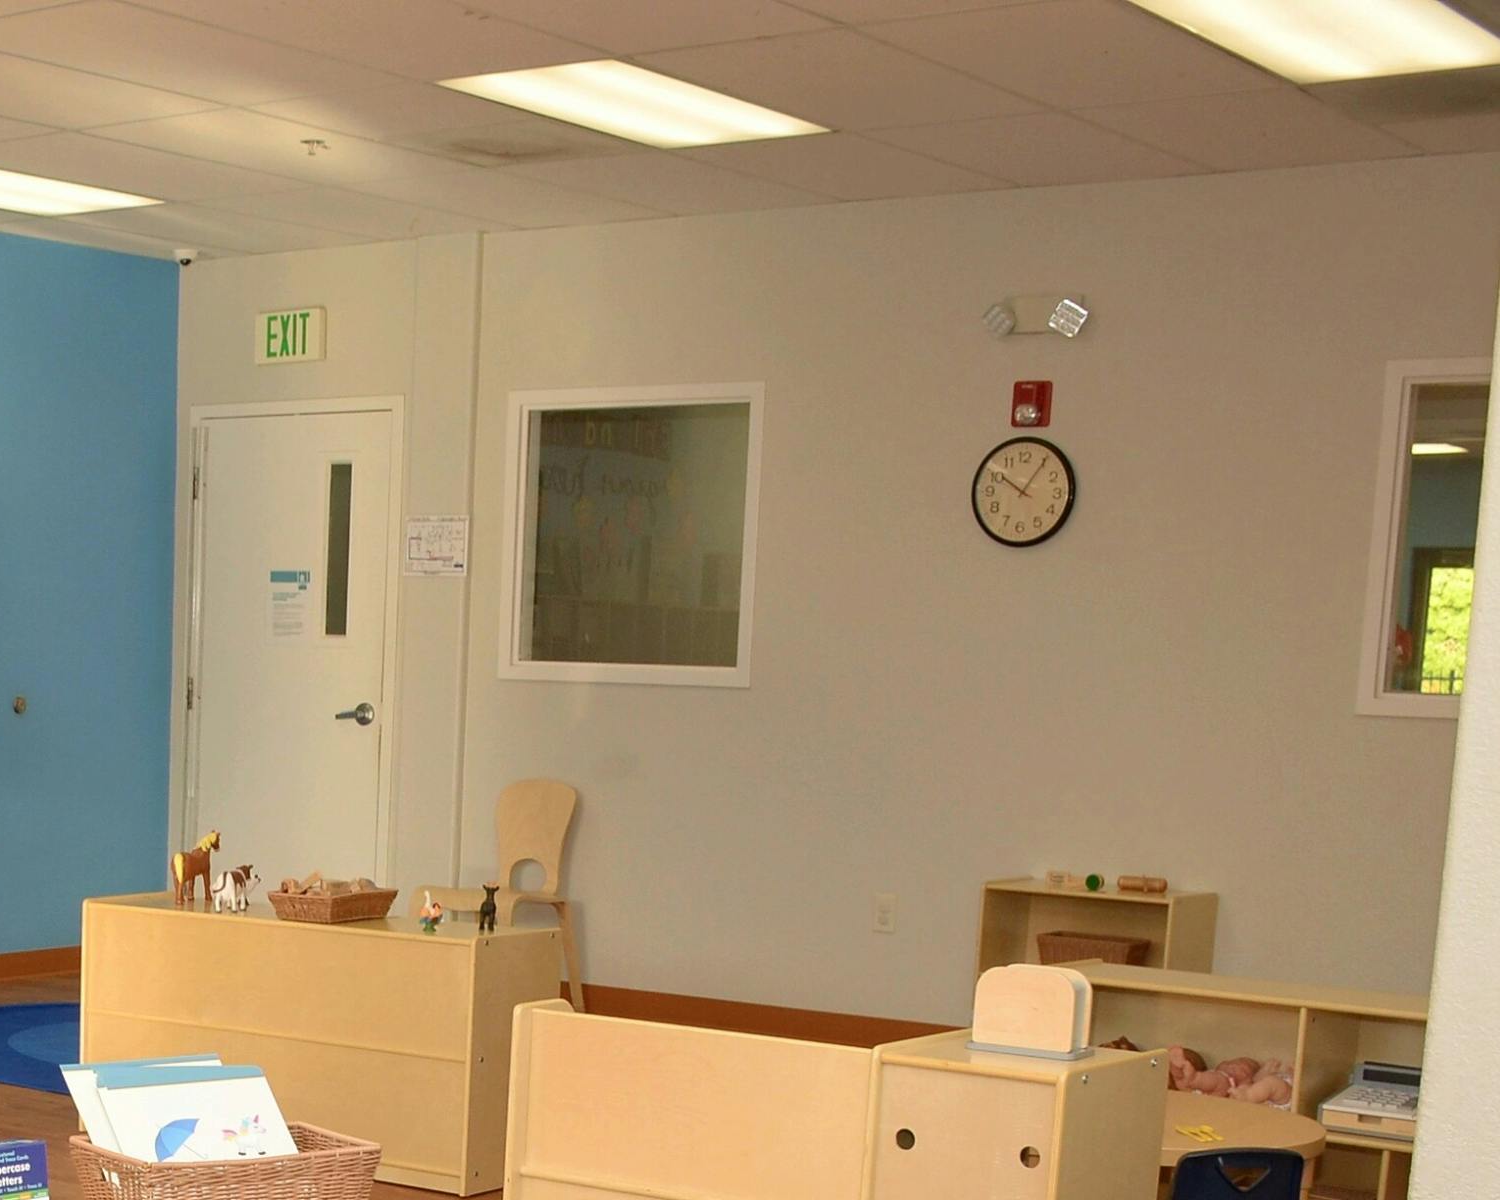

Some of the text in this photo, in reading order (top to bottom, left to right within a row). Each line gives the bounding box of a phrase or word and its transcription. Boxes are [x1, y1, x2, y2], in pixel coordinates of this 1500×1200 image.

[266, 312, 310, 358] EXIT
[1004, 457, 1014, 468] 11
[1019, 452, 1032, 463] 12
[991, 472, 1004, 483] 10
[1049, 472, 1058, 483] 2
[985, 486, 995, 497] 9
[1053, 488, 1062, 499] 3
[990, 502, 1000, 513] 8
[1046, 504, 1055, 515] 4
[1003, 515, 1011, 526] 7
[1033, 517, 1043, 528] 5
[1015, 522, 1025, 533] 6
